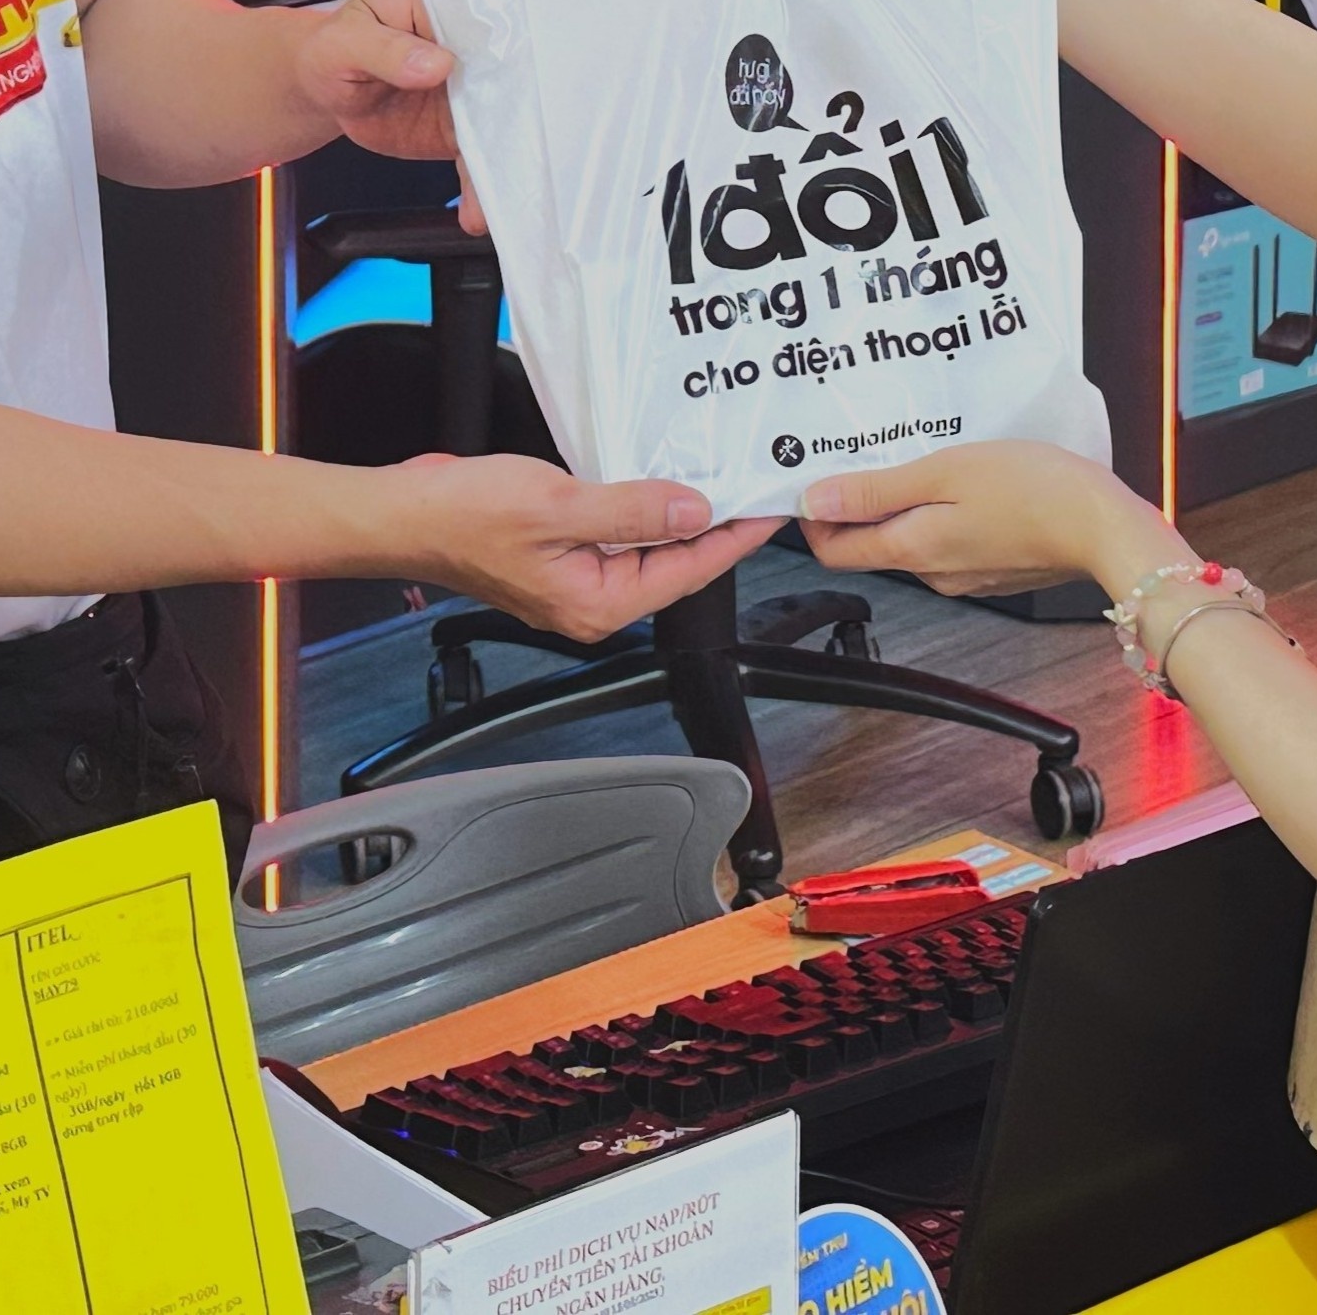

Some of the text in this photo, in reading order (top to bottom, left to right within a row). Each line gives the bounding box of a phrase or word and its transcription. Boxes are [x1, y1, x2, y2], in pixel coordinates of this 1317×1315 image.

[668, 238, 1008, 336] trong 1 tháng
[683, 293, 1029, 399] cho điện thoại lỗi
